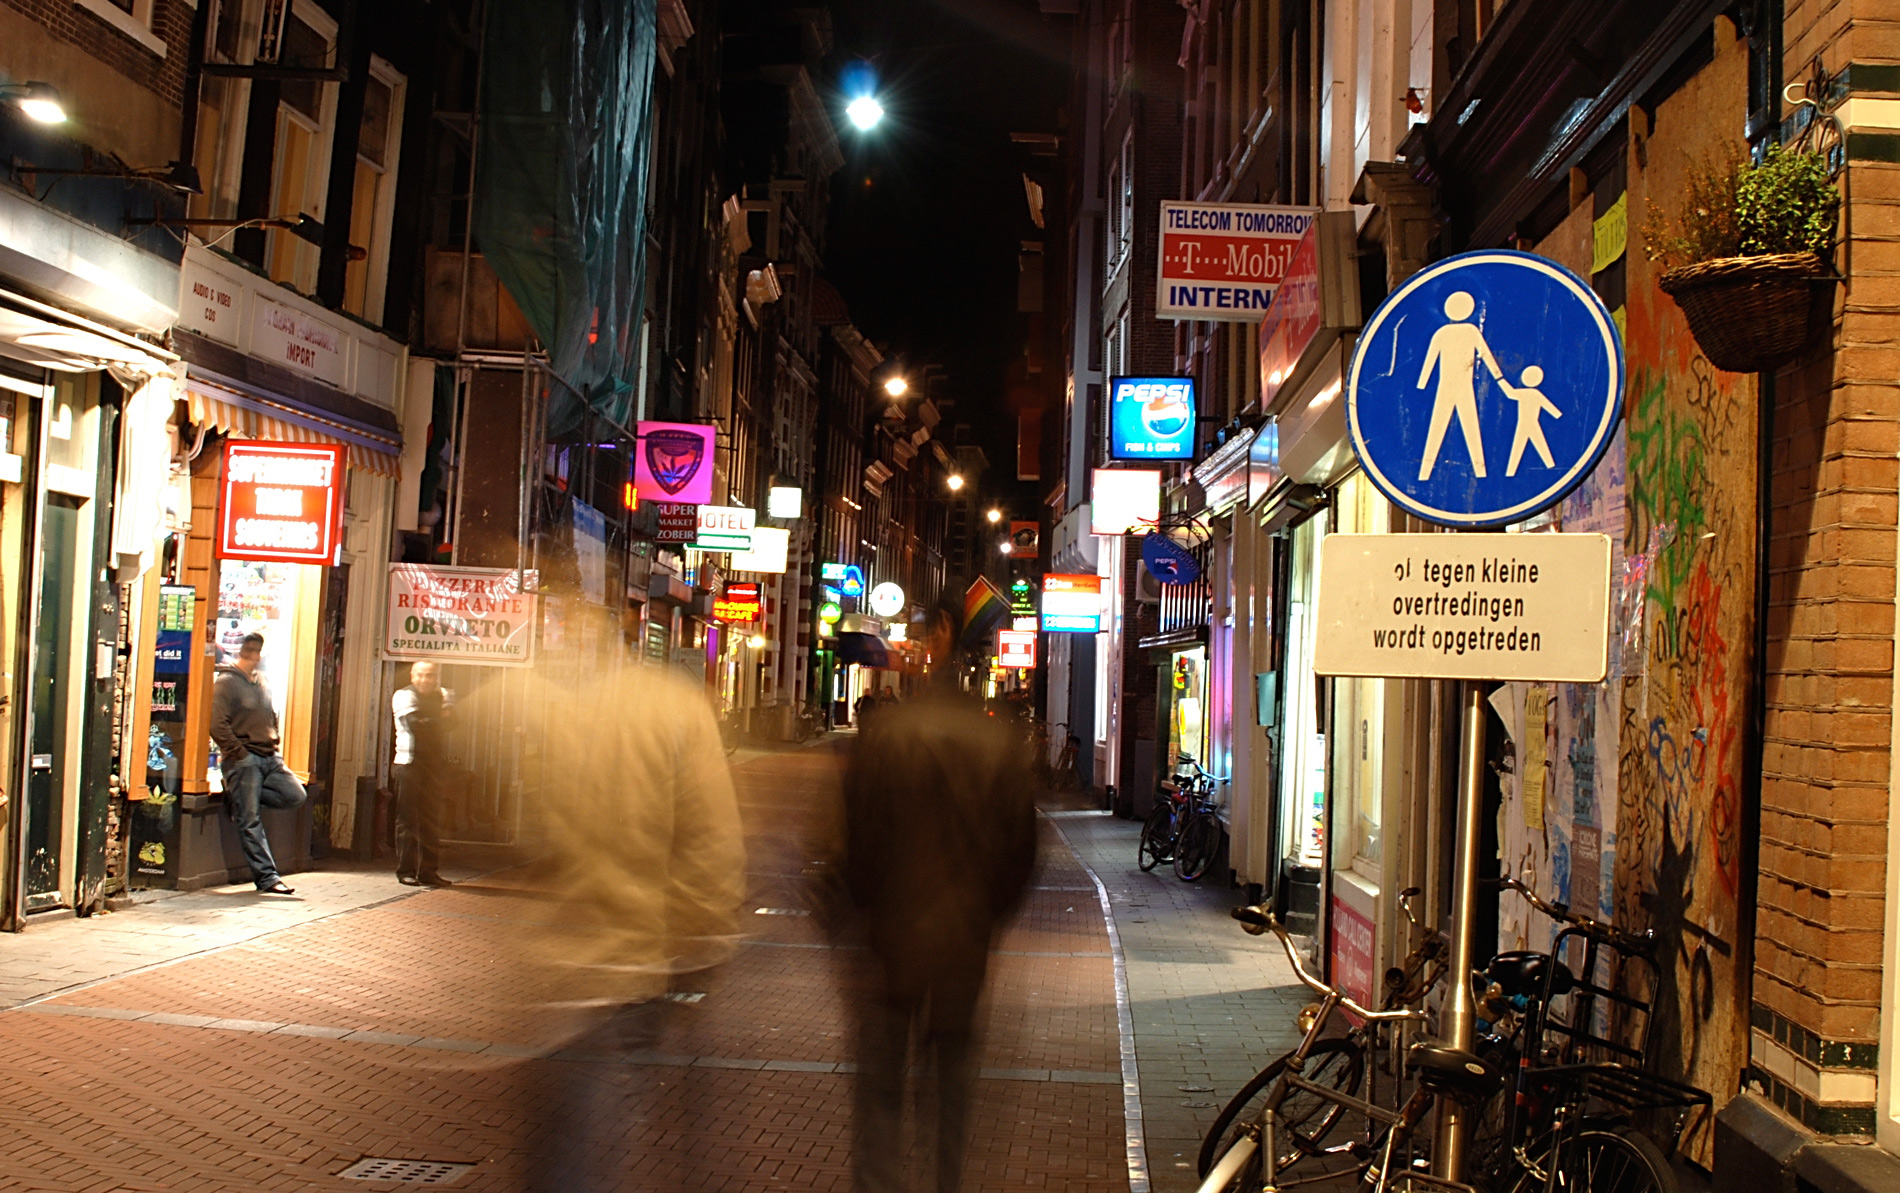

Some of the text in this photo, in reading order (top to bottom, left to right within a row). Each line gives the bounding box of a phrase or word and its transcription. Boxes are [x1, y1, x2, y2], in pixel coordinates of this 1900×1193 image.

[1167, 209, 1232, 231] TELECOM
[192, 281, 209, 299] AUDIO
[216, 291, 232, 308] VIDEO
[1169, 286, 1278, 310] INTERN
[204, 307, 216, 322] CDS
[1116, 384, 1190, 402] PEPSI
[1125, 443, 1145, 452] FISH
[1155, 443, 1181, 452] CHIPS
[657, 504, 695, 515] SUPER
[659, 518, 693, 527] MARKET
[657, 530, 694, 540] ZOBEIR
[1424, 558, 1475, 588] tegen
[1482, 557, 1539, 583] kleine
[397, 593, 522, 614] RISTORANTE
[1393, 591, 1524, 622] overtredingen
[404, 615, 511, 639] ORVIETO
[465, 642, 520, 656] ITALIANE
[1373, 624, 1541, 655] wordt opgetreden
